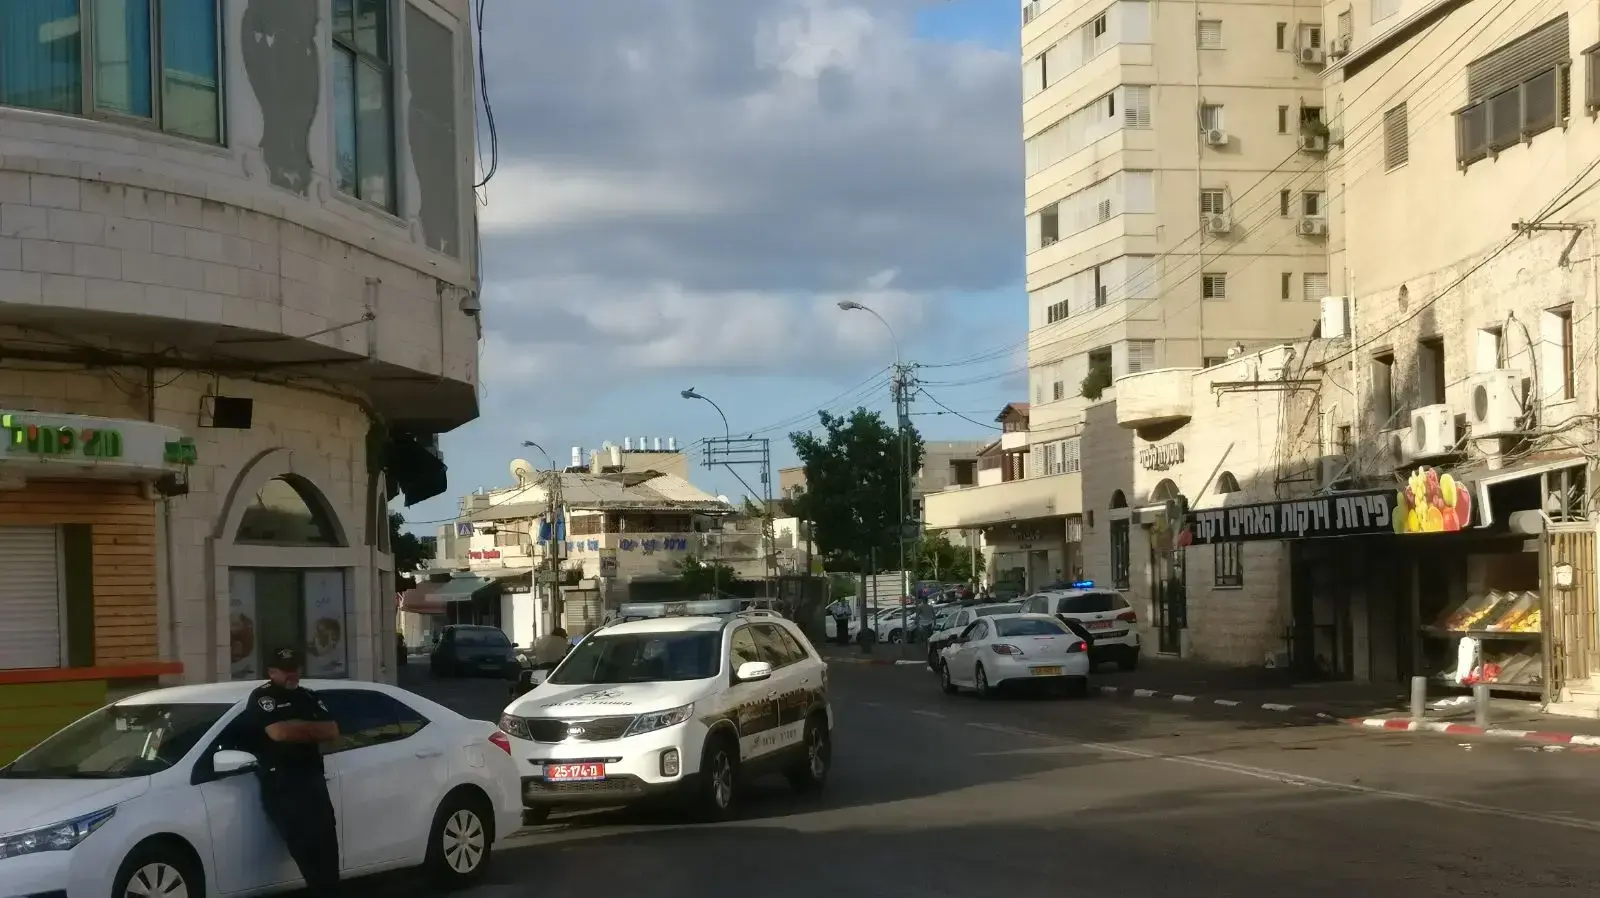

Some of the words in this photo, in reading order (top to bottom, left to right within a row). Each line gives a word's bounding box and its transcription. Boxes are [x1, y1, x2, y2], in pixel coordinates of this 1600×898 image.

[1196, 511, 1224, 543] דקה
[1228, 505, 1275, 535] האחים
[1281, 499, 1330, 536] וירקות
[1336, 495, 1389, 528] פירות
